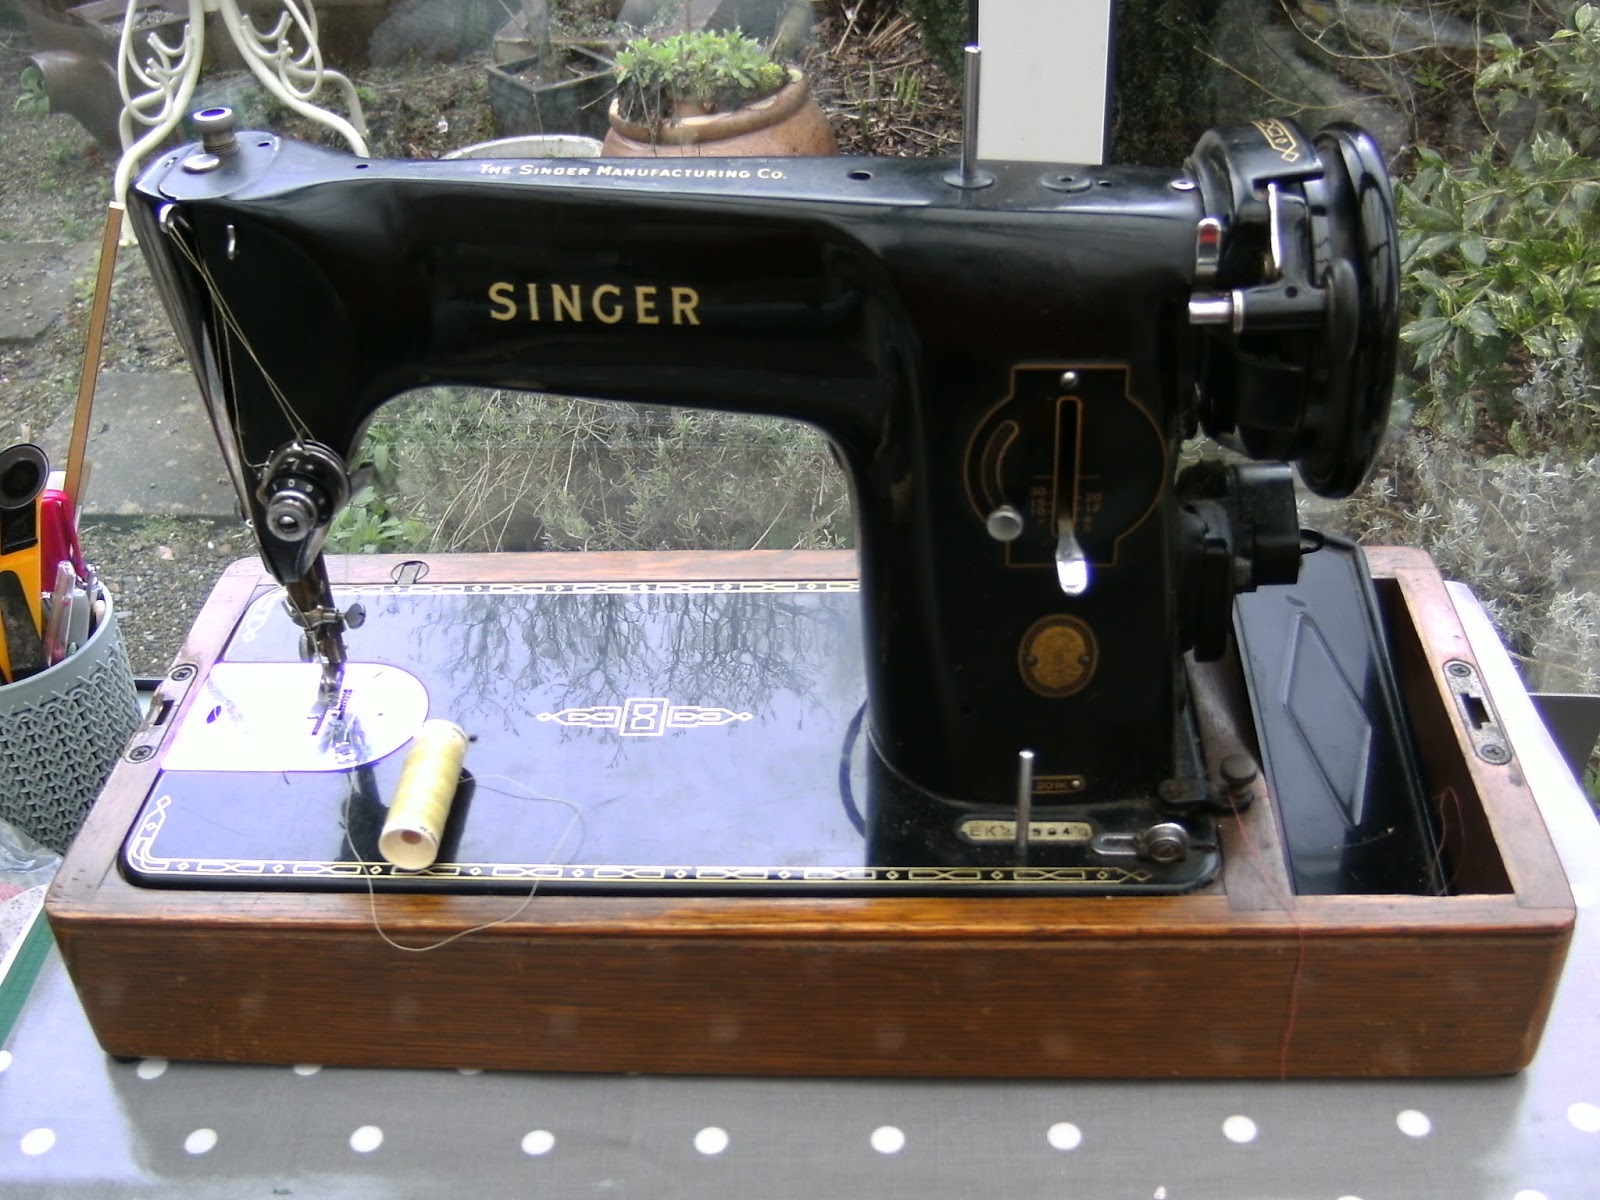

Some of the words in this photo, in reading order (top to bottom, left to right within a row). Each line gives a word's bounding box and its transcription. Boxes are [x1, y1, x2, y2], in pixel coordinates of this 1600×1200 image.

[518, 164, 592, 176] SINGER
[596, 166, 751, 179] MANUFACTURING
[488, 281, 701, 326] SINGER
